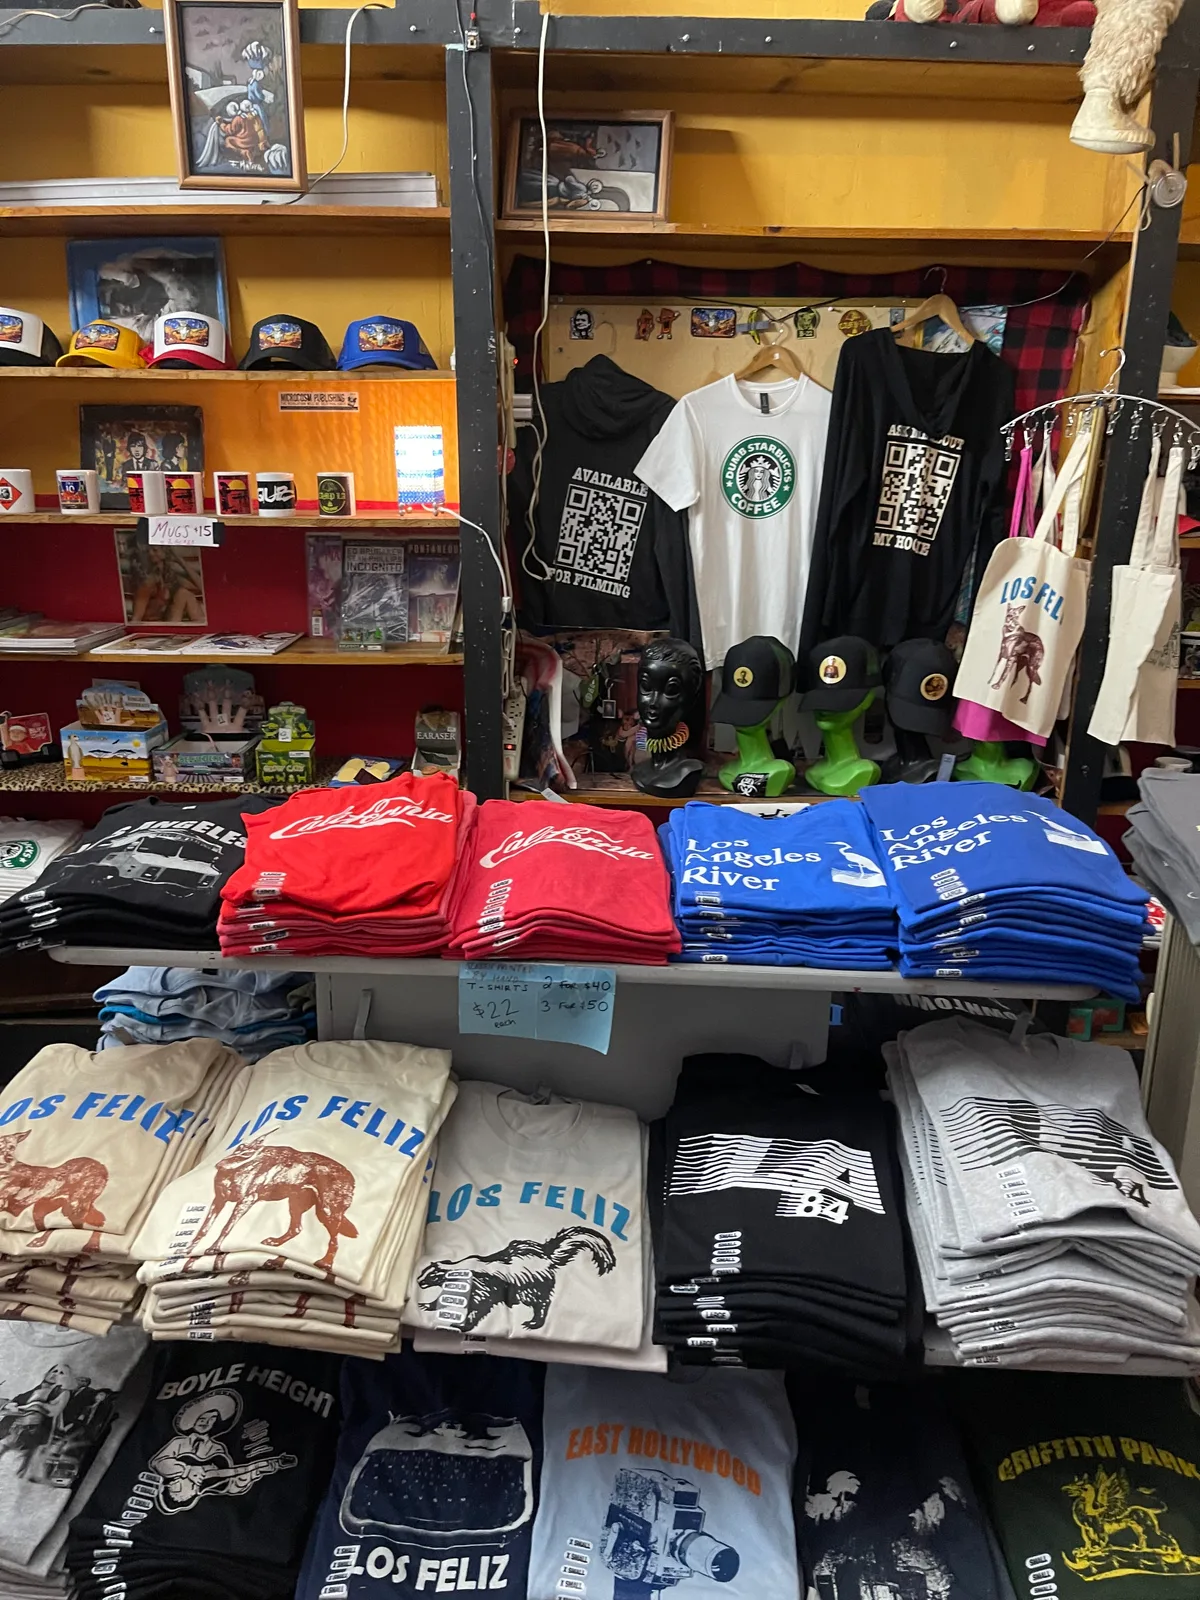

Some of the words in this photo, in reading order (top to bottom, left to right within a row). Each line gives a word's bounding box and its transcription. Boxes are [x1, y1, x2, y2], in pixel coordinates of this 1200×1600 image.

[725, 447, 748, 480] DUMB
[747, 442, 793, 484] STARBUCKS
[571, 466, 650, 498] AVAILABLE
[730, 492, 782, 515] COFFEE
[151, 520, 190, 539] MUGS
[194, 525, 212, 537] $15
[872, 532, 895, 547] MY
[346, 562, 403, 572] INCOGNITO
[548, 566, 572, 585] FOR
[572, 571, 632, 599] FILMING
[1000, 576, 1038, 605] LOS
[416, 731, 457, 741] EARASER
[880, 815, 949, 842] Los
[886, 812, 1029, 857] Angeles
[479, 825, 655, 869] California
[685, 838, 750, 853] Los
[890, 830, 993, 873] River
[684, 847, 823, 869] Angeles
[681, 865, 780, 892] River
[466, 982, 529, 992] T-SHIRTS
[543, 976, 552, 990] 2
[585, 981, 611, 991] $40
[472, 999, 520, 1019] $22
[541, 1001, 551, 1012] 3
[494, 1019, 517, 1028] each
[0, 1094, 66, 1127] OS
[72, 1092, 195, 1144] FELIZ
[226, 1094, 308, 1150] LOS
[317, 1095, 426, 1160] FELIZ
[186, 1205, 206, 1213] LARGE
[426, 1183, 503, 1224] LOS
[519, 1181, 631, 1242] FELIZ
[180, 1217, 201, 1225] LARGE
[175, 1229, 195, 1237] LARGE
[168, 1241, 189, 1249] LARGE
[441, 1295, 465, 1306] MEDIUM
[439, 1310, 462, 1321] MEDIUM
[156, 1362, 247, 1401] BOYLE
[565, 1422, 625, 1461] EAST
[627, 1426, 763, 1497] HOLLYWOOD
[998, 1435, 1117, 1482] GRIFFITH
[1118, 1436, 1200, 1481] PARK
[345, 1545, 411, 1584] LOS
[415, 1553, 511, 1593] FELIZ
